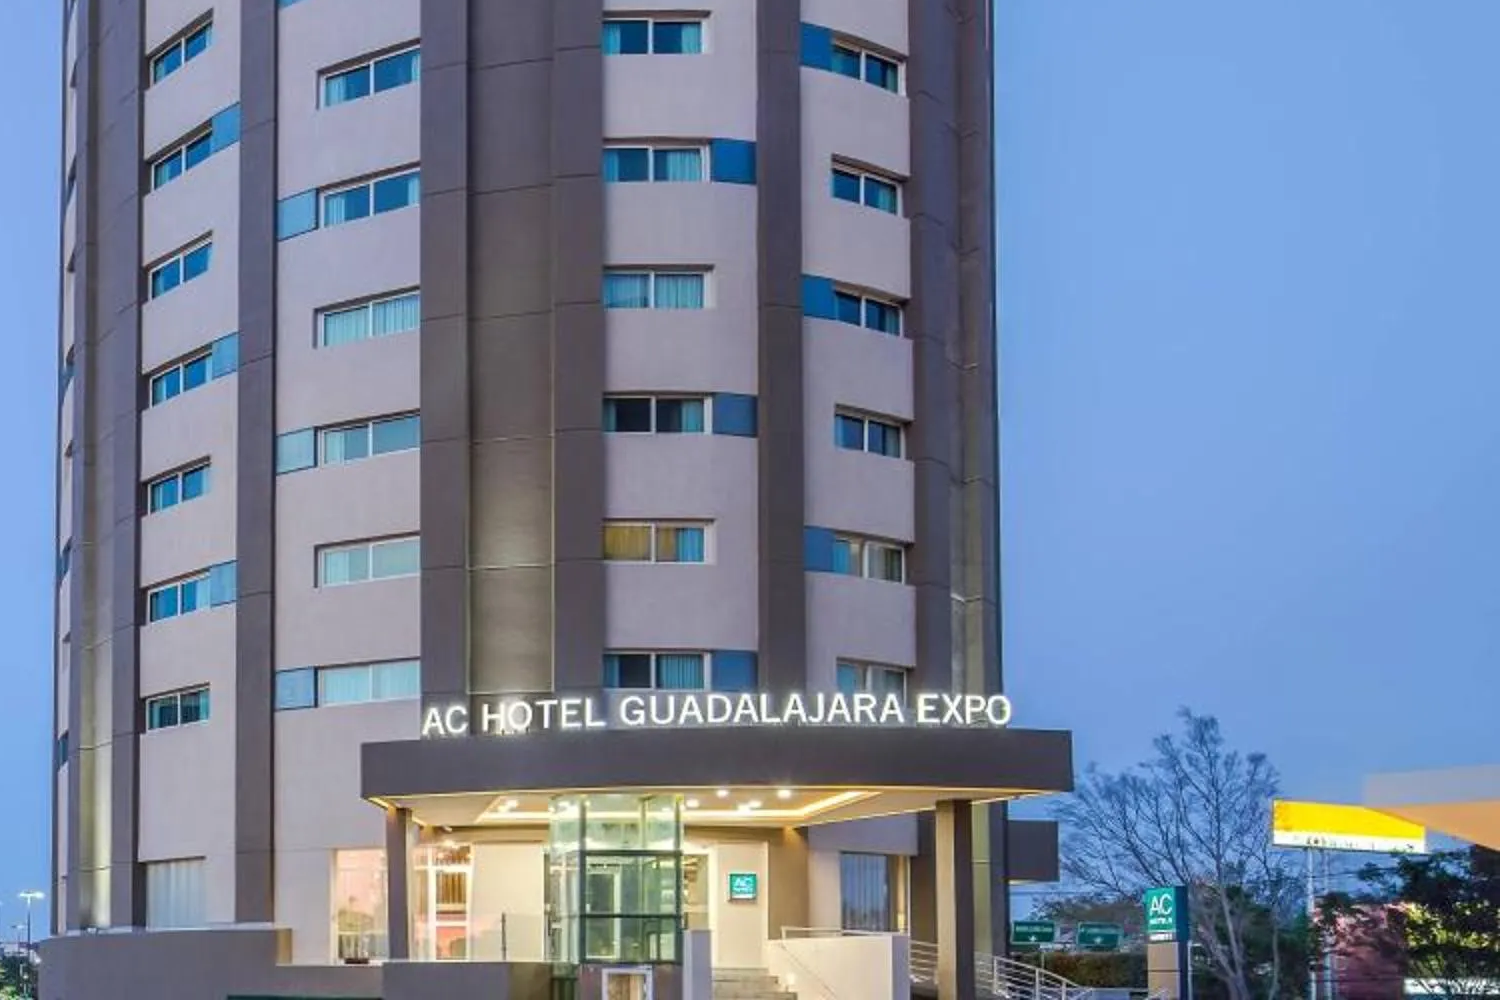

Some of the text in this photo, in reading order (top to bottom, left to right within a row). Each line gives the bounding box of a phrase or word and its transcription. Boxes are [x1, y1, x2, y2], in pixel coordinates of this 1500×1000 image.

[422, 692, 1012, 736] AC HOTEL GUADALAJARA EXPO
[1149, 893, 1173, 917] AC
